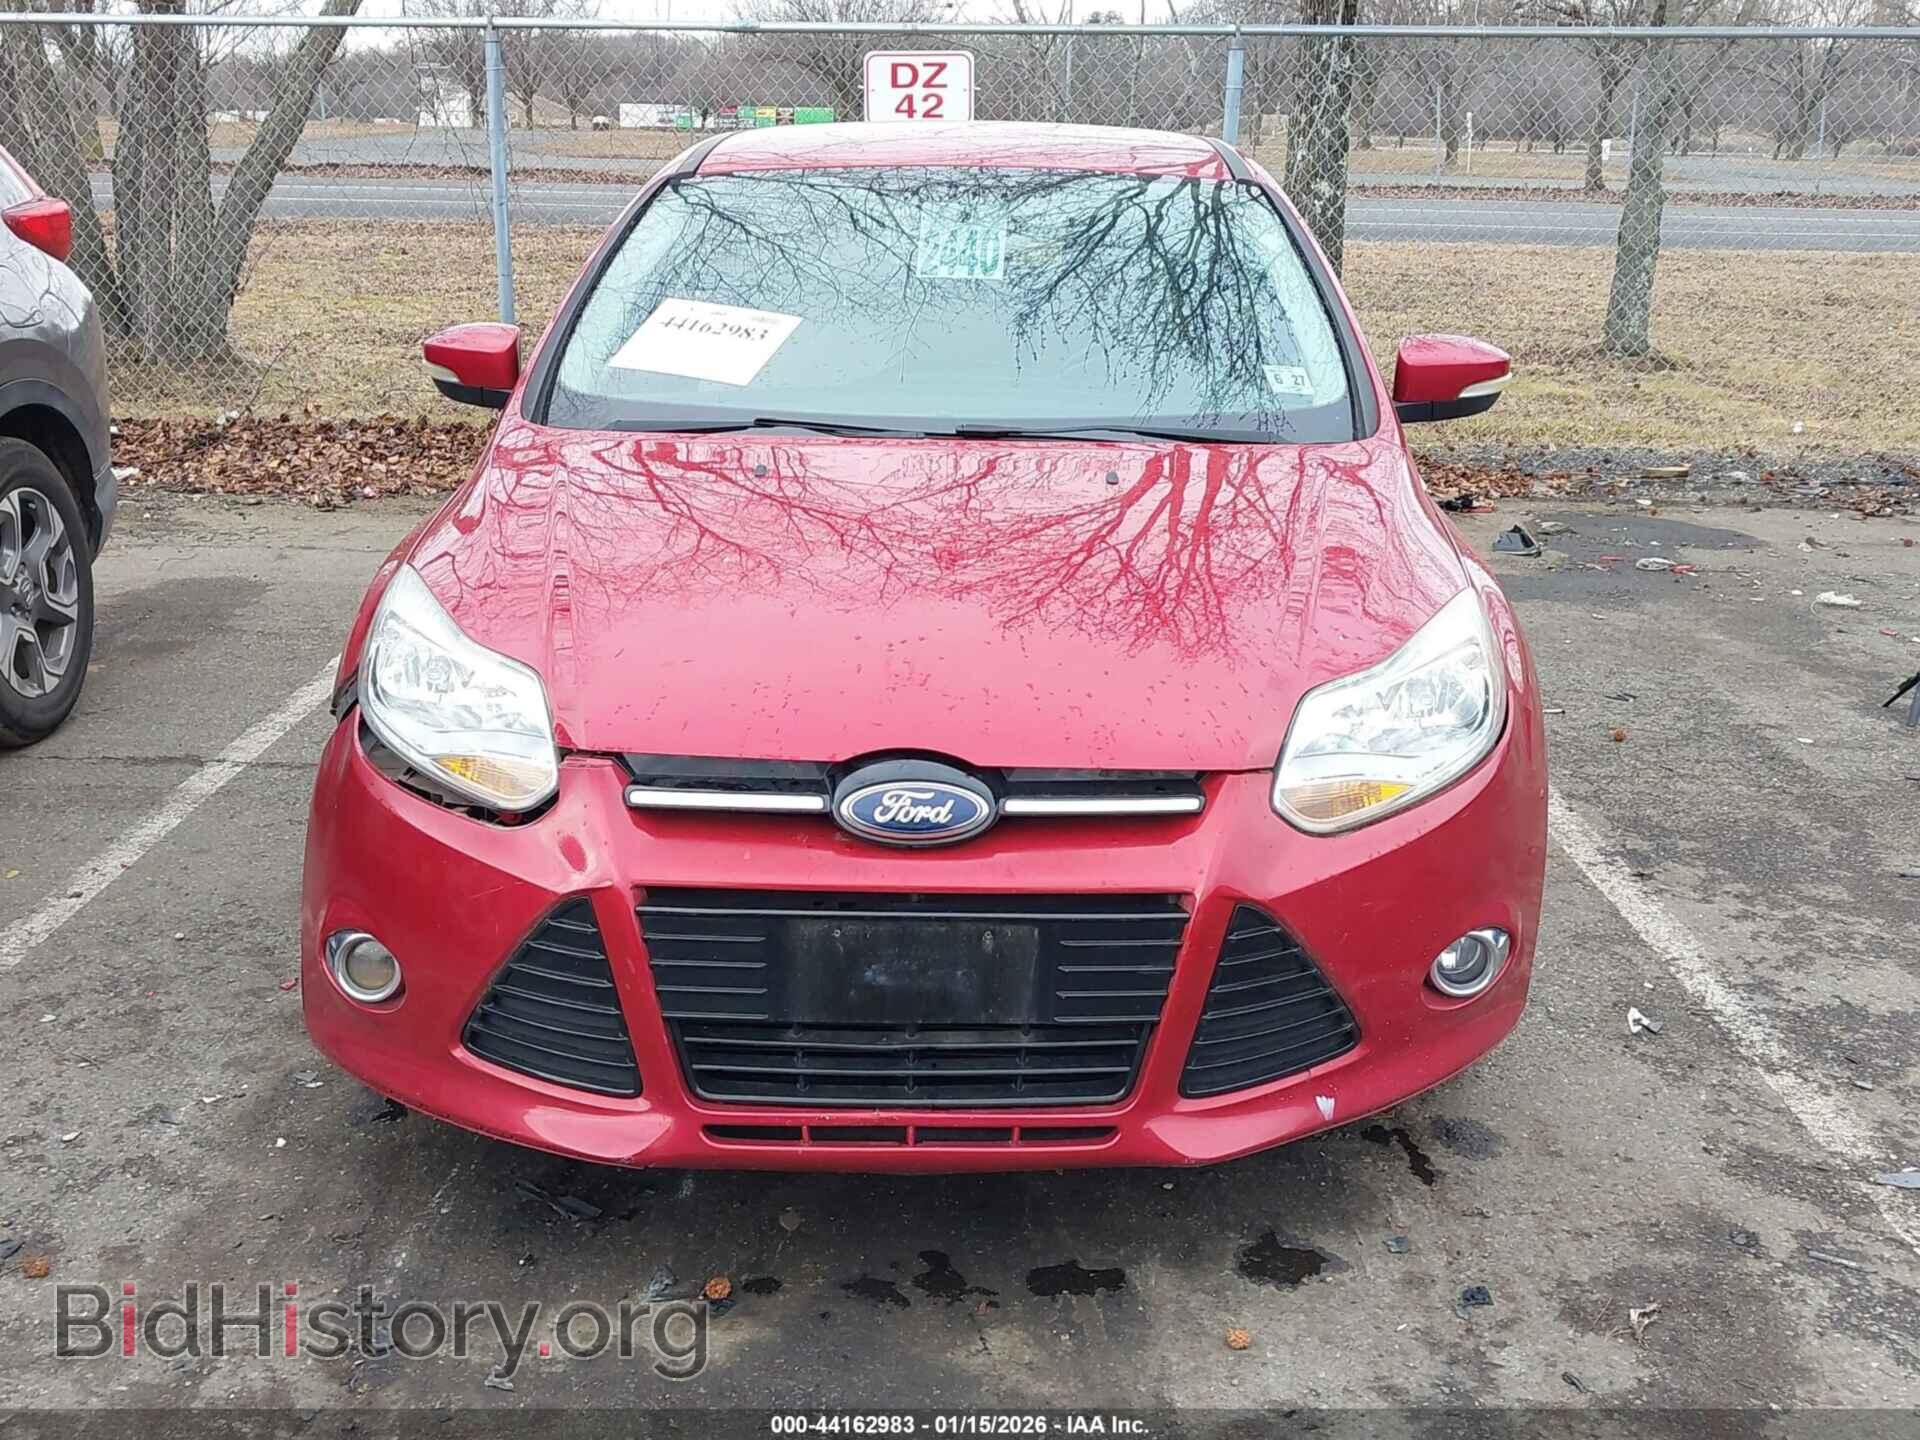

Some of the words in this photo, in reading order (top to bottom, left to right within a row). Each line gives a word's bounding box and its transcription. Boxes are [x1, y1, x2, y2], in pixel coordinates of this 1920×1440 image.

[890, 62, 948, 88] DZ
[895, 93, 944, 119] 42
[1291, 374, 1305, 387] 27
[873, 789, 953, 824] Ford
